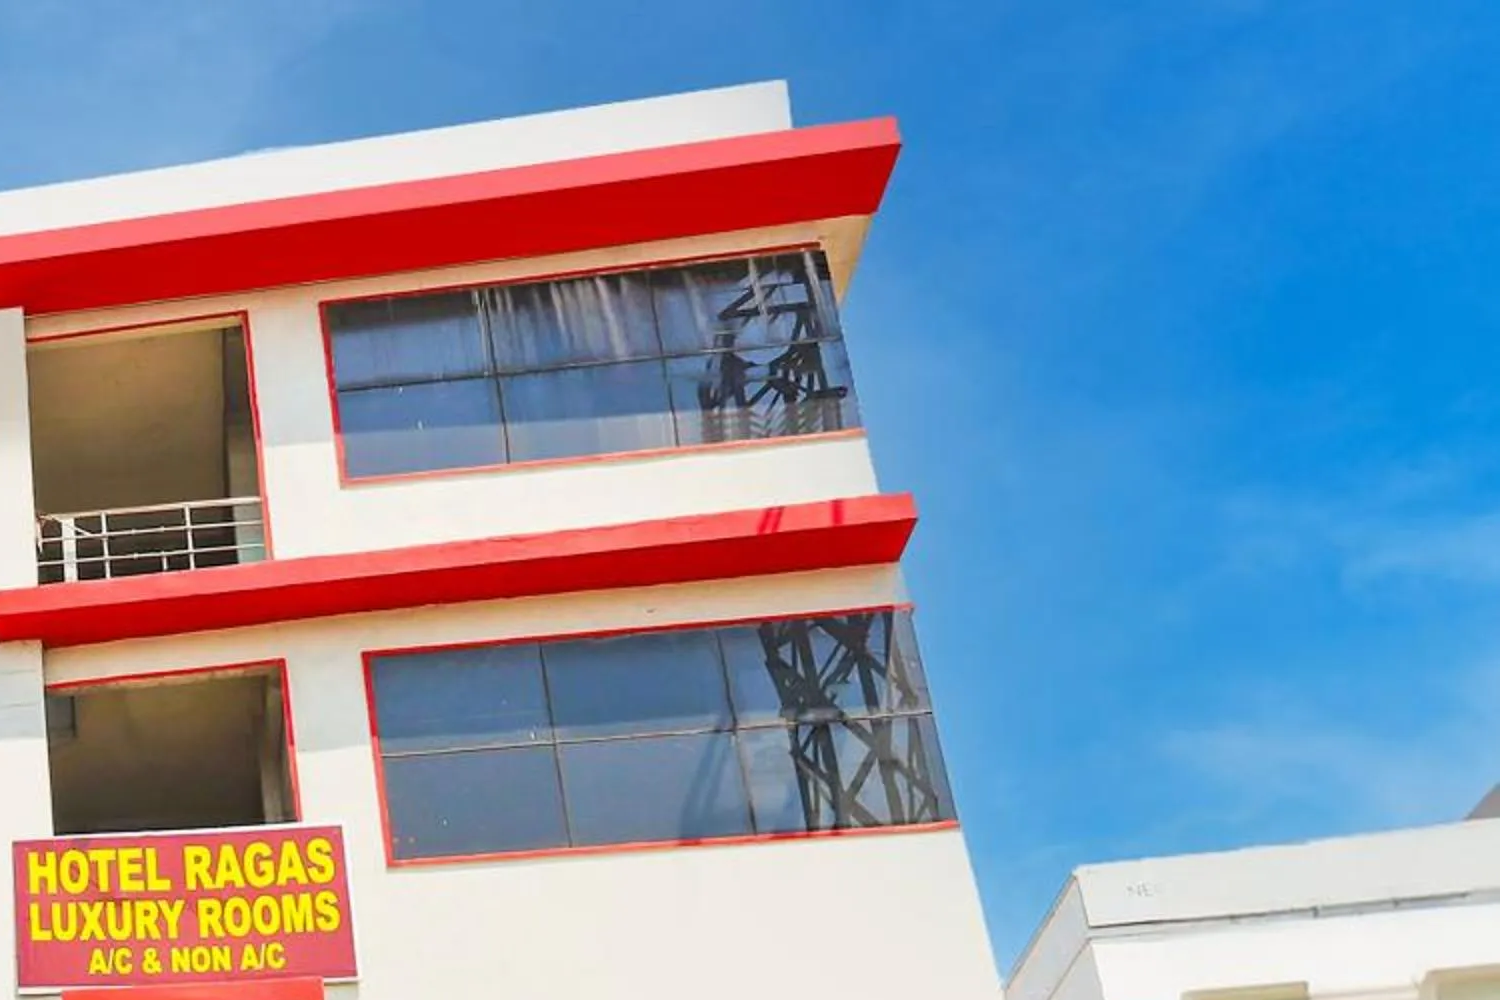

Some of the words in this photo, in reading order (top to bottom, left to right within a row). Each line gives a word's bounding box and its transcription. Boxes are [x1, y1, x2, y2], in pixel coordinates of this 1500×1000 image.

[27, 846, 172, 895] HOTEL
[183, 838, 336, 891] RAGAS
[29, 900, 185, 941] LUXURY
[197, 889, 341, 938] ROOMS
[88, 946, 133, 974] A/C
[142, 948, 162, 974] &
[170, 945, 231, 973] NON
[241, 942, 286, 971] A/C
